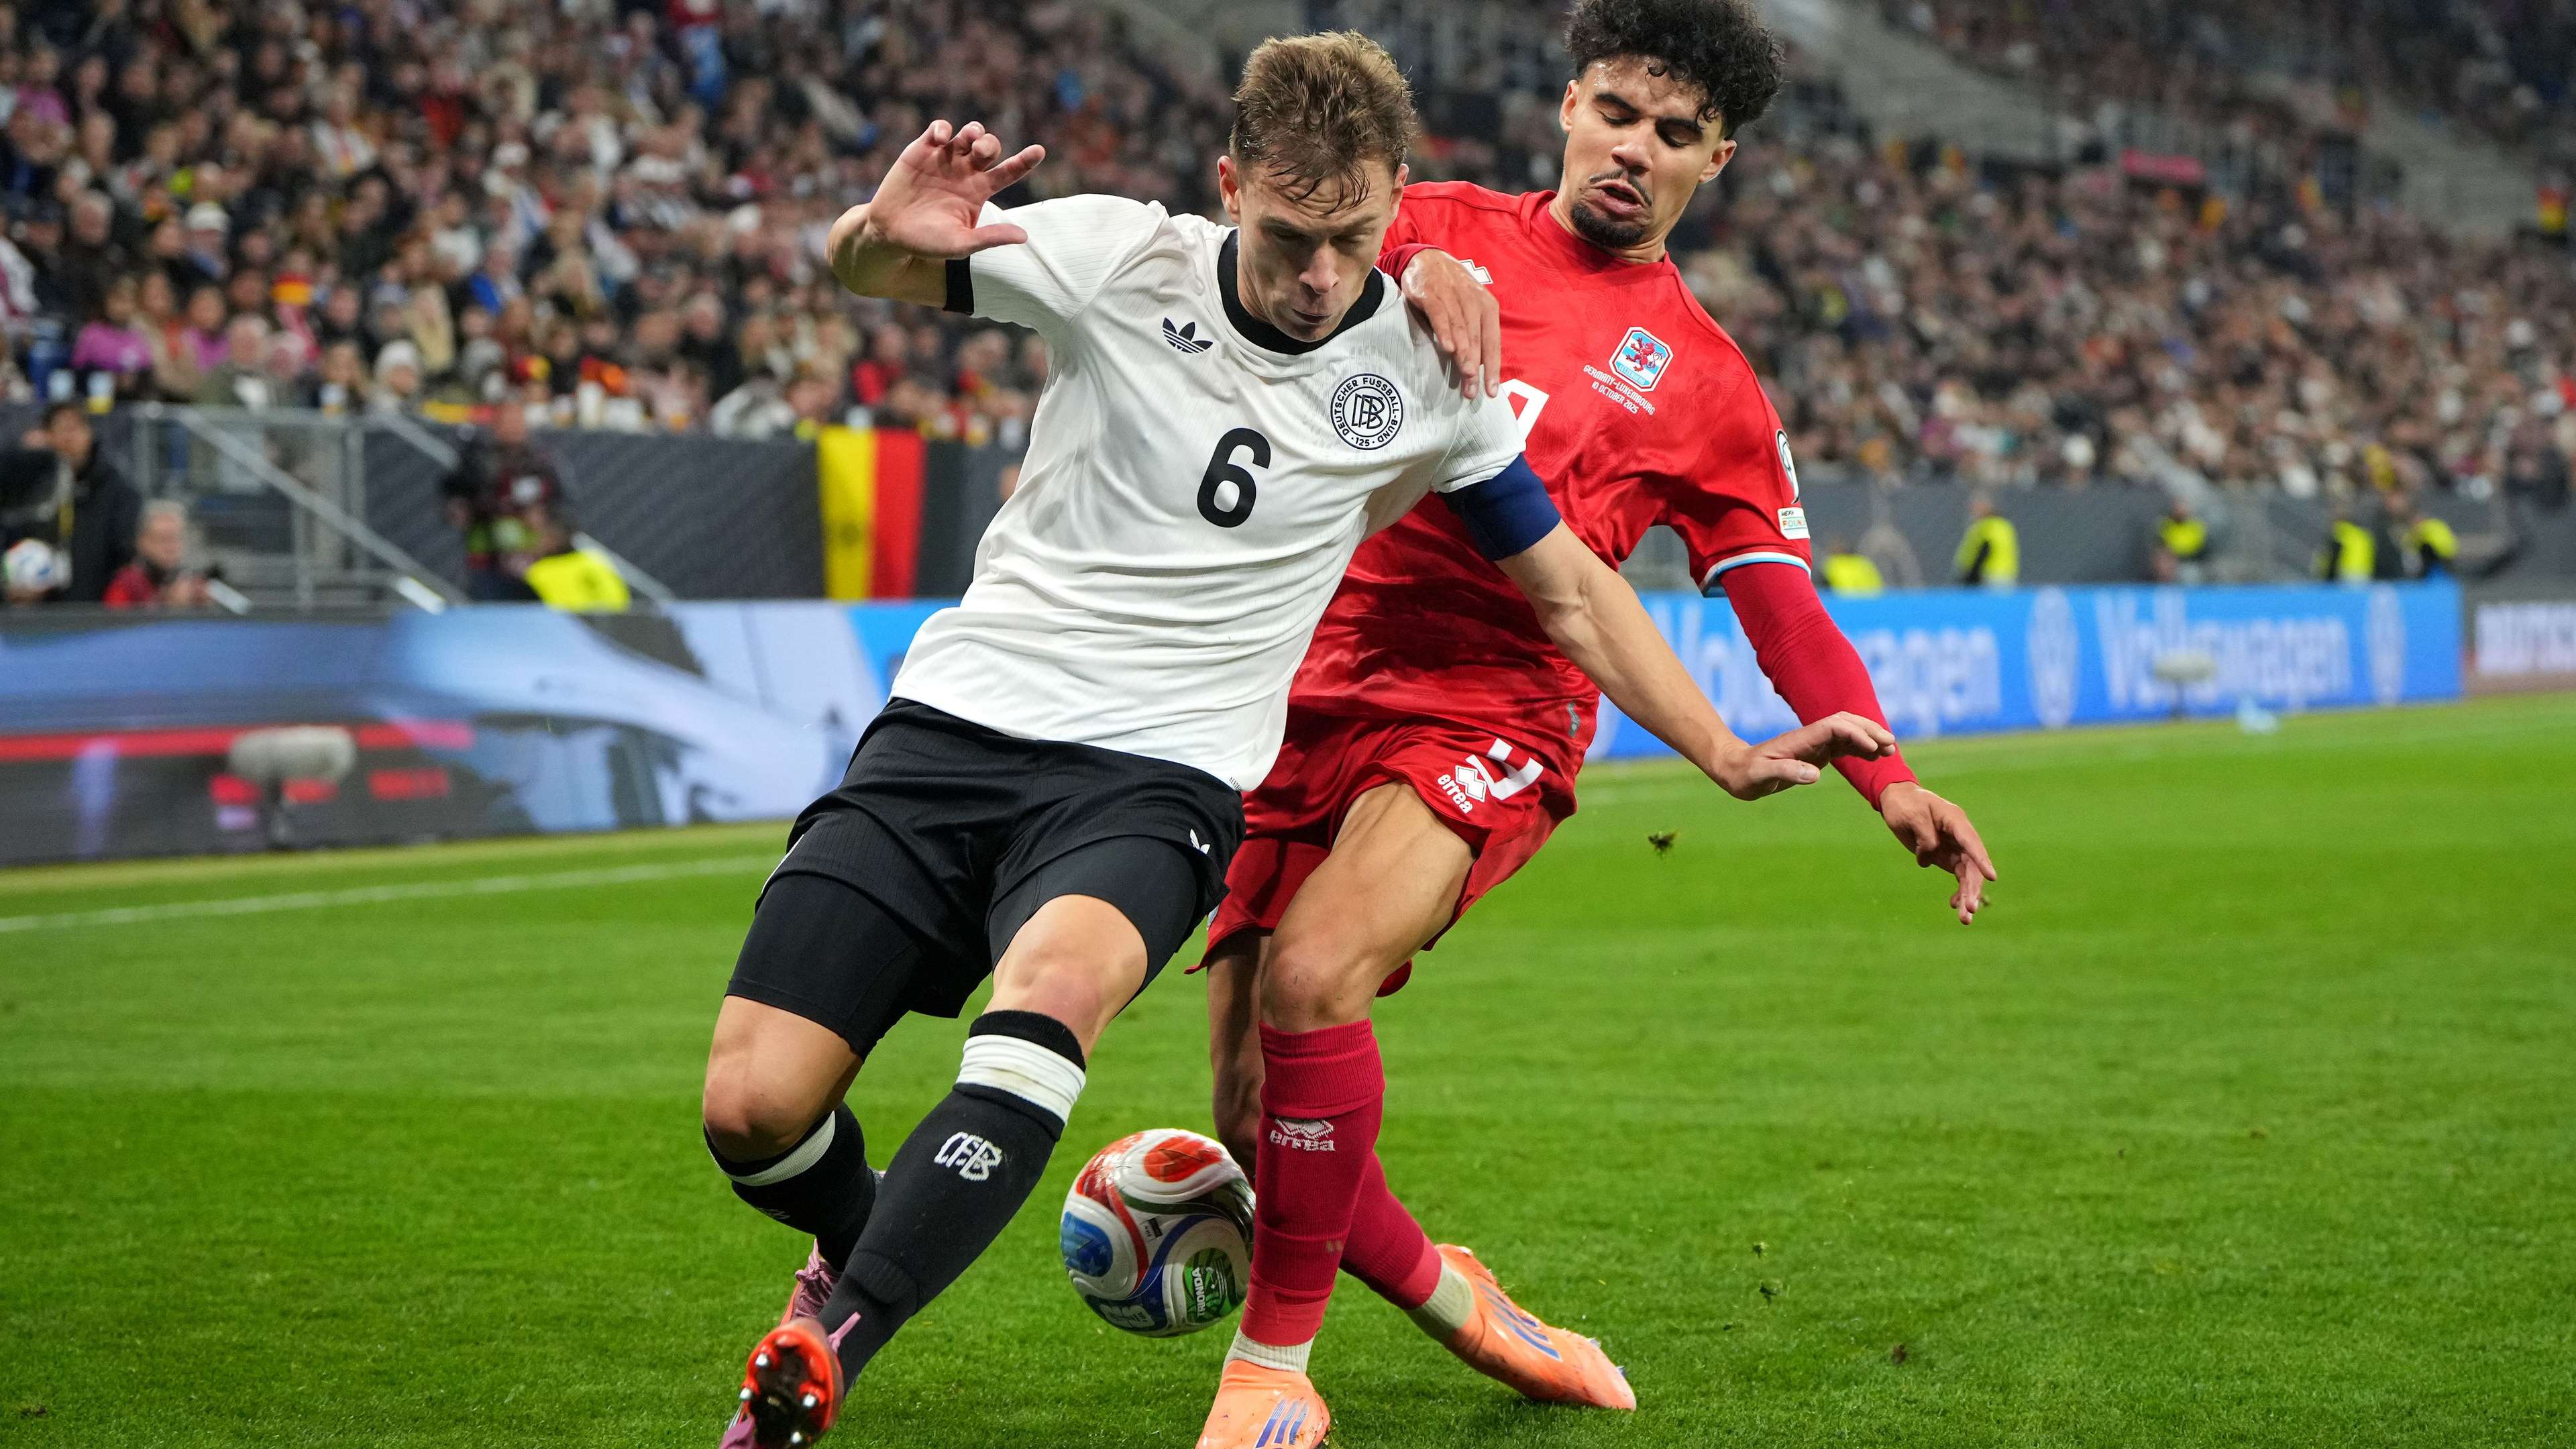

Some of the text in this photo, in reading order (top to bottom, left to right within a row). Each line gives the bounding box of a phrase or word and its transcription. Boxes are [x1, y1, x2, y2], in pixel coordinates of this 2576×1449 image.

[1334, 377, 1399, 443] DEUTSCHER FUSSBALL-BUND
[1583, 364, 1656, 415] GERMANY-LUXEMBOURG
[1591, 380, 1640, 414] 10 OCTOBER 2025
[1355, 437, 1370, 447] 125
[1197, 427, 1271, 528] 6
[1191, 1267, 1206, 1318] TRIONDA
